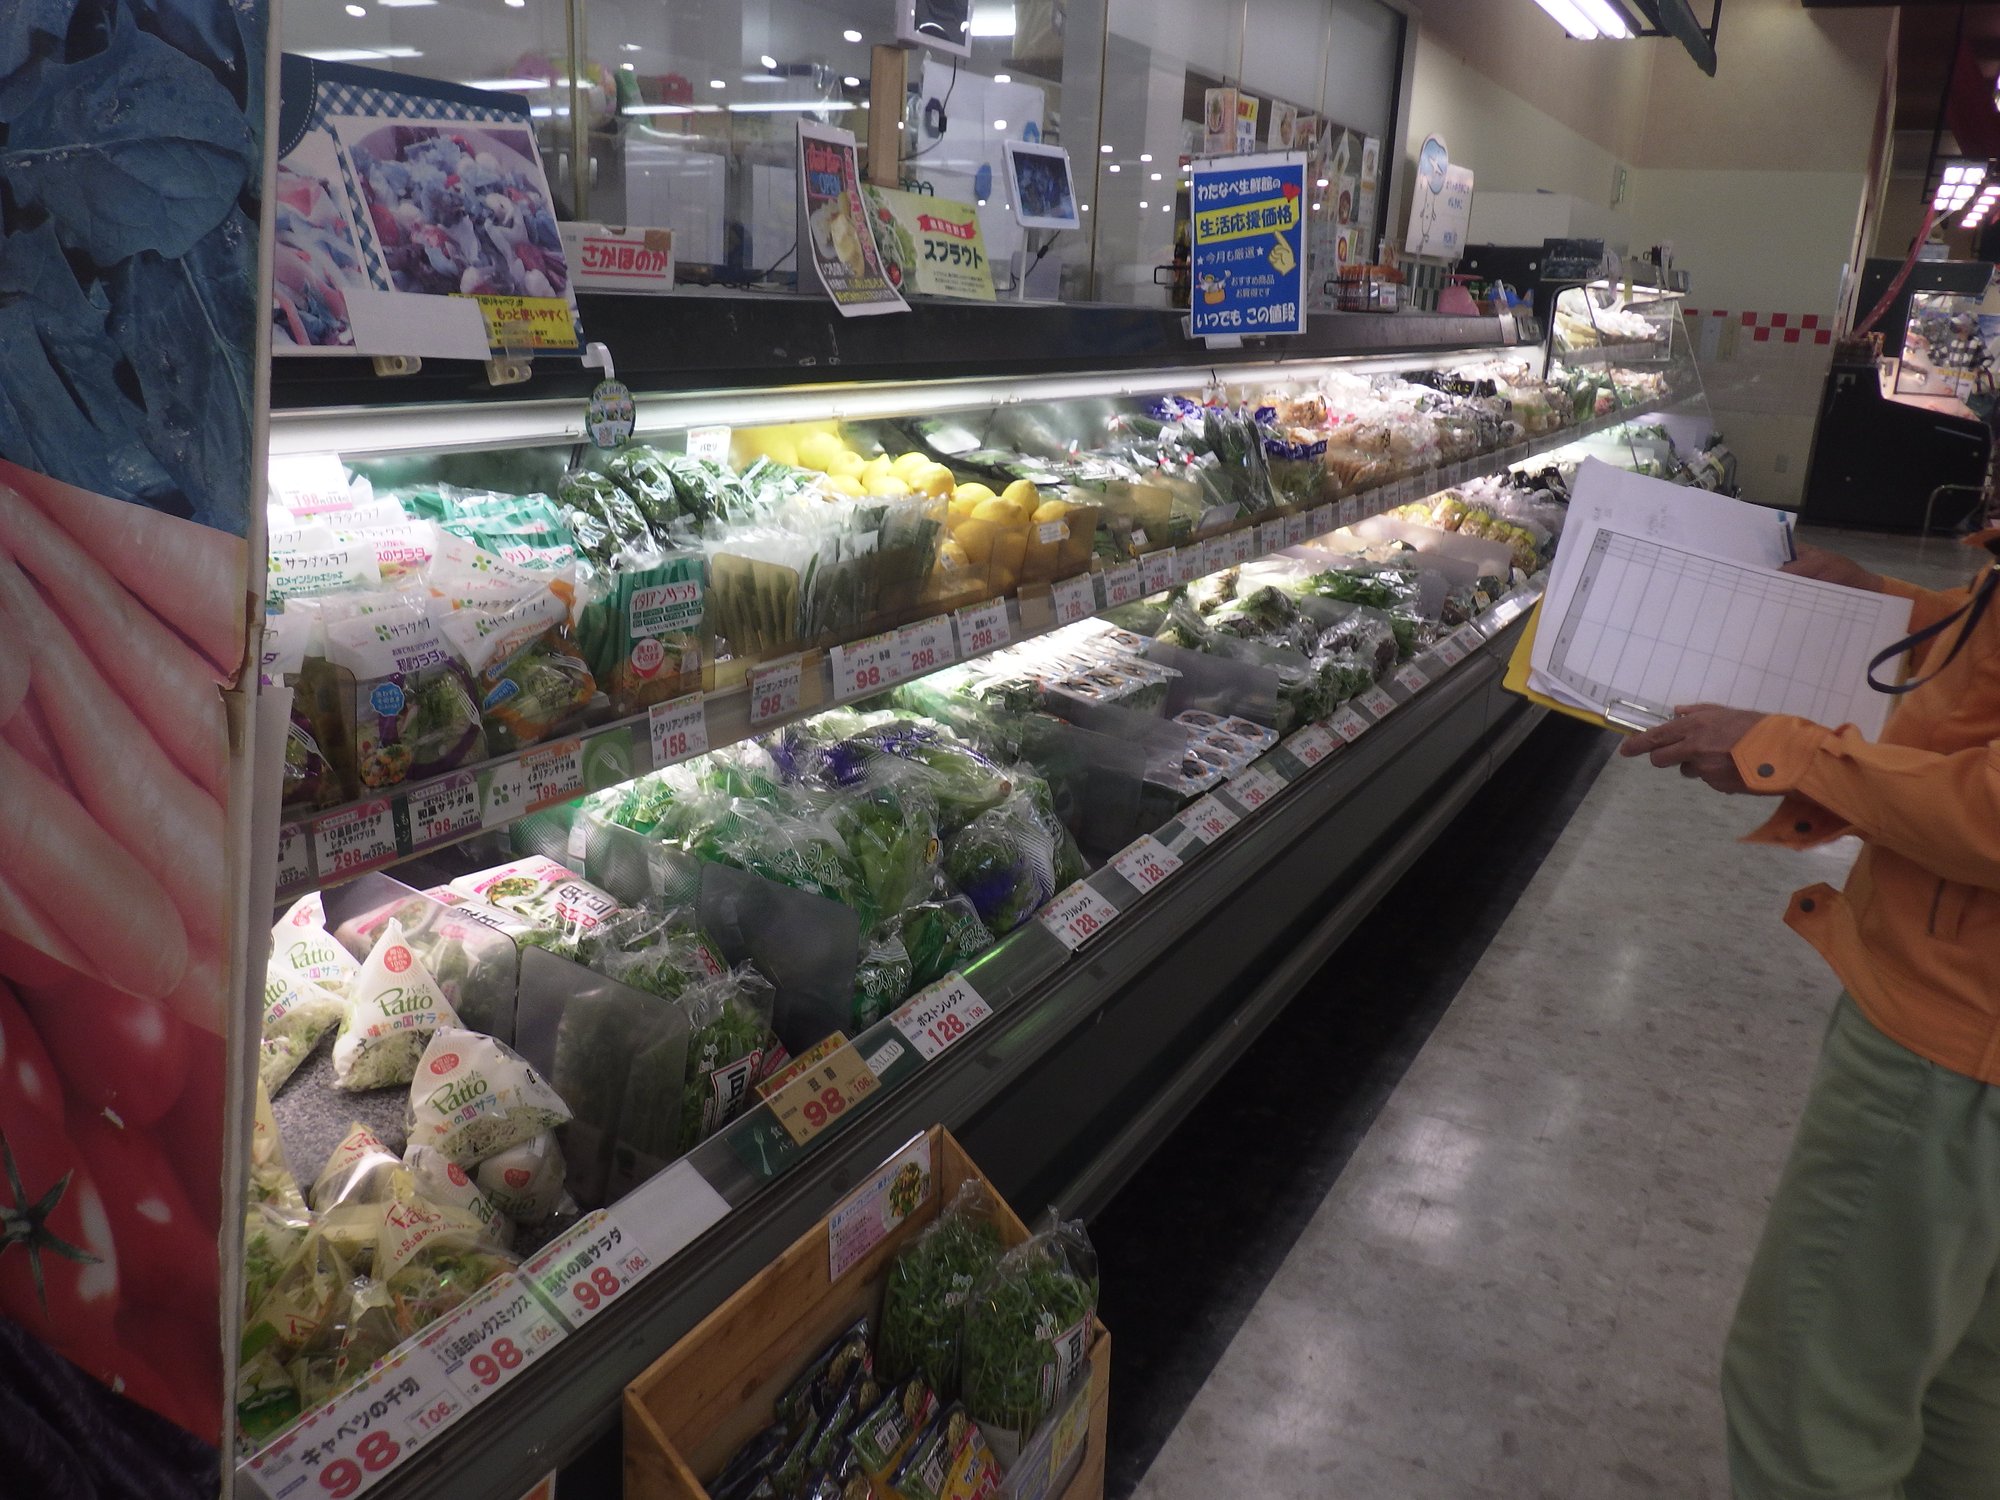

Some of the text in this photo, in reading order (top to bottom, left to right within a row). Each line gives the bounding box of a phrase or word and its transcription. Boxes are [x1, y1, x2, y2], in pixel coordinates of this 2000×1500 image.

[1200, 204, 1293, 239] 生活応援価格
[581, 245, 669, 273] さがほのか
[923, 240, 984, 269] スプラウト
[1196, 302, 1296, 328] いつでも この値段
[971, 629, 994, 651] 298
[911, 650, 935, 673] 298
[855, 665, 882, 690] 98
[760, 693, 782, 718] 98
[652, 711, 703, 738] イタリアンサラダ
[661, 731, 688, 760] 158
[1304, 747, 1322, 763] 98
[535, 782, 559, 802] 198
[1245, 787, 1266, 805] 38
[426, 817, 452, 839] 198
[1202, 817, 1226, 837] 198
[333, 848, 363, 871] 298
[1138, 862, 1165, 886] 128
[1068, 913, 1099, 940] 128
[373, 987, 434, 1018] Patto
[927, 1012, 966, 1048] 128
[868, 1041, 901, 1073] SALAD
[424, 1078, 488, 1116] Patto
[803, 1086, 847, 1128] 98
[572, 1265, 621, 1311] 98
[469, 1336, 524, 1386] 98
[300, 1376, 421, 1467] キャベツの千切
[318, 1429, 401, 1499] 98
